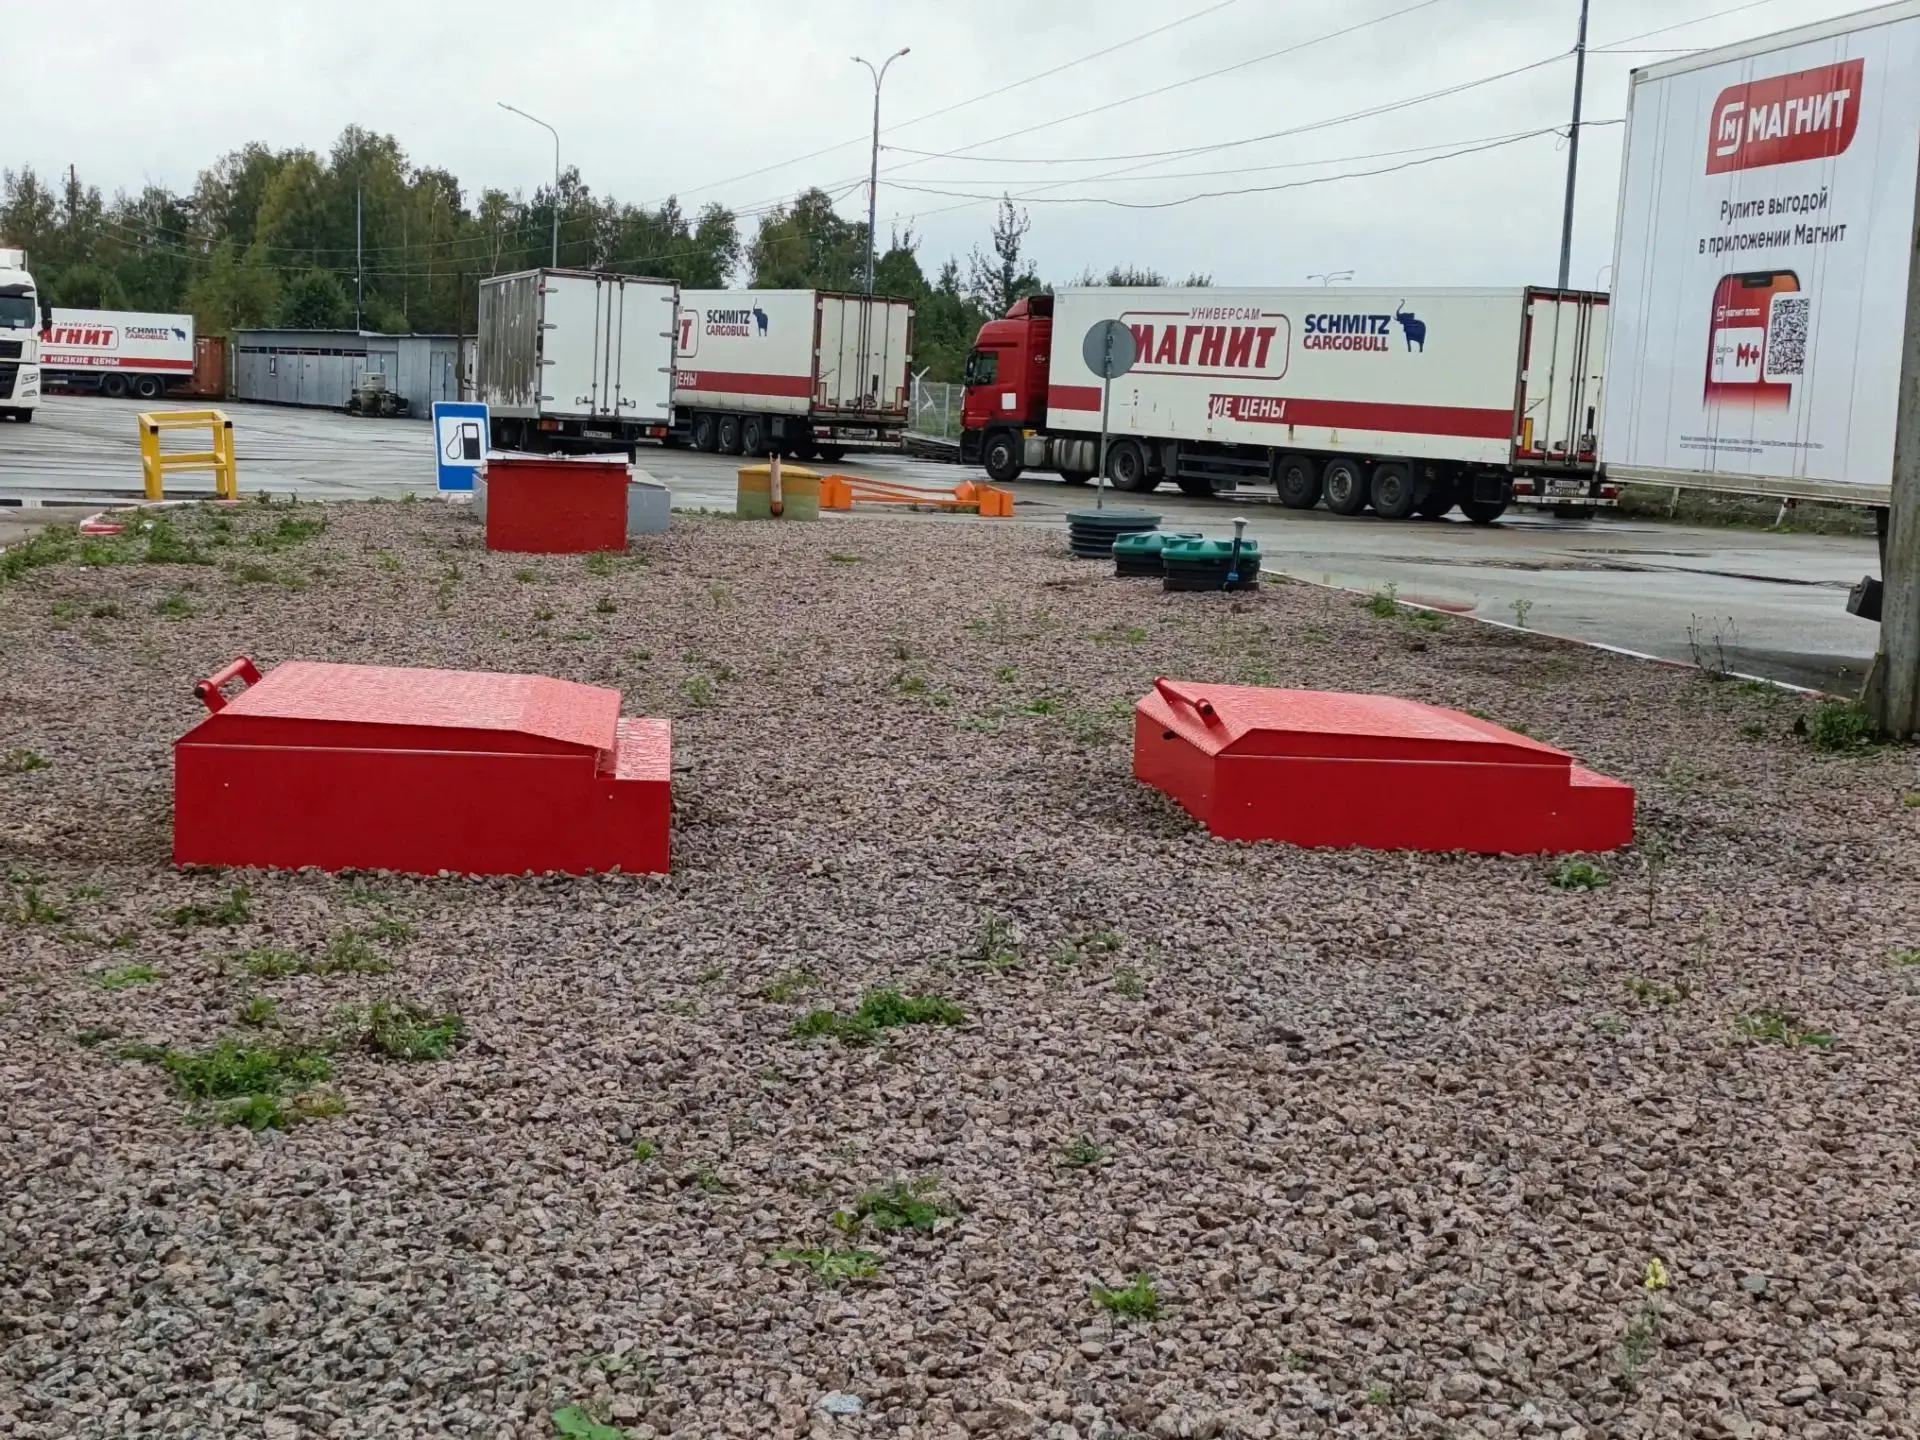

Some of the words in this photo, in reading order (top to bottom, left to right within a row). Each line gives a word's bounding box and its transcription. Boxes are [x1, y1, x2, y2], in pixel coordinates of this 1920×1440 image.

[1747, 88, 1851, 143] МАГНИТ
[1720, 200, 1765, 225] Рулите
[1768, 186, 1828, 215] выгодой
[1699, 238, 1706, 254] в
[1708, 229, 1791, 258] приложении
[1794, 224, 1847, 245] Магнит
[706, 310, 751, 324] SCHMITZ
[1190, 307, 1261, 321] УНИВЕРСАМ
[125, 327, 169, 335] SCHMITZ
[706, 325, 750, 337] CARGOBULL
[1304, 313, 1391, 335] SCHMITZ
[40, 327, 113, 345] АГНИТ
[1303, 335, 1389, 352] CARGOBULL
[50, 355, 89, 364] НИЗКИЕ
[92, 357, 120, 366] ЦЕНЫ
[676, 371, 698, 386] ЕНЫ
[1238, 399, 1286, 419] ЦЕНЫ
